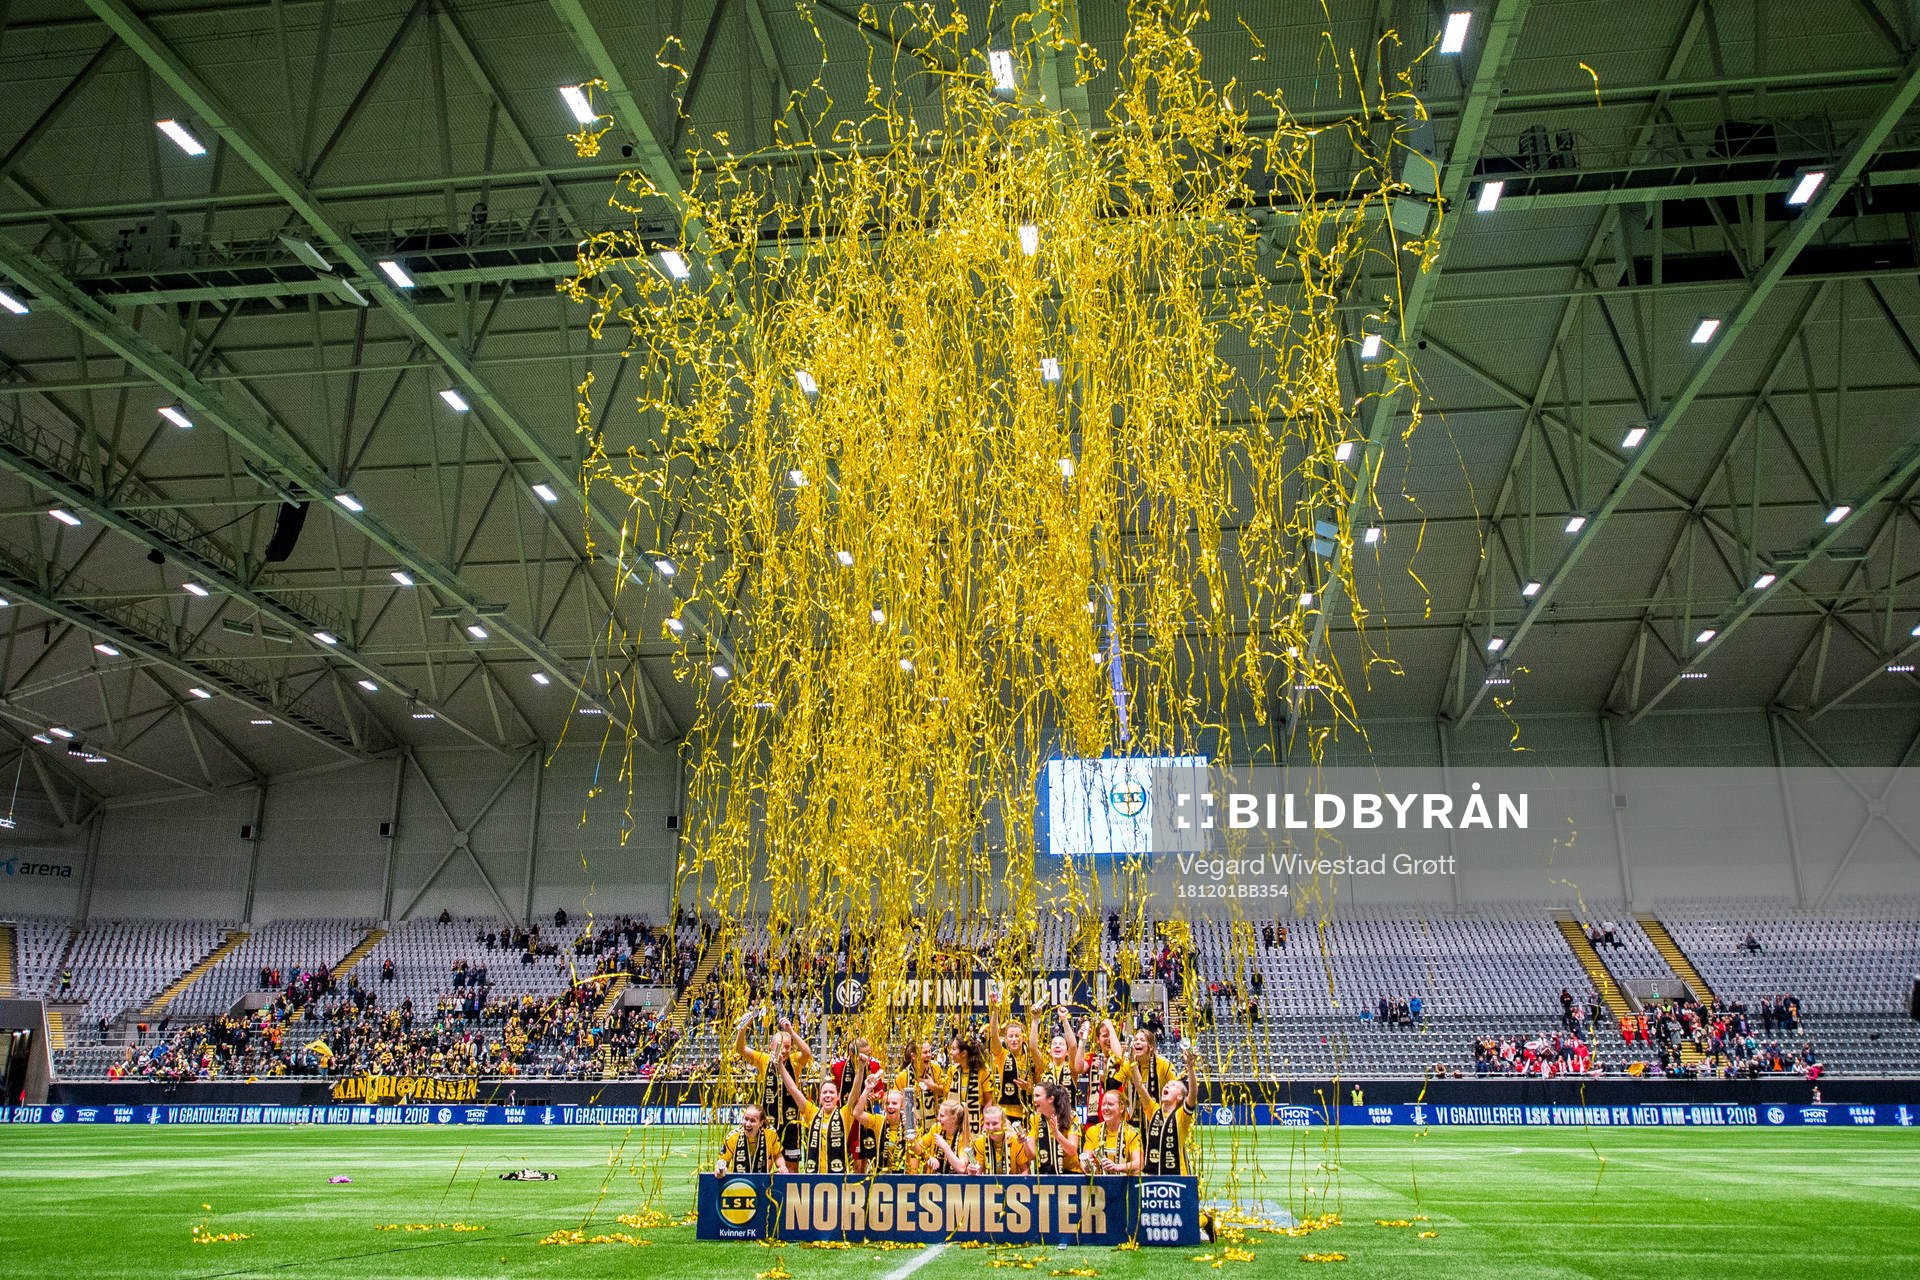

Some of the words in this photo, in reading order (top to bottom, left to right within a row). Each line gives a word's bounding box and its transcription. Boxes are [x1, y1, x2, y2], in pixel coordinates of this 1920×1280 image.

[20, 862, 72, 878] arena
[334, 1076, 397, 1099] KANRI
[414, 1077, 478, 1100] FANSEN
[13, 1107, 42, 1123] 2018
[168, 1107, 179, 1123] VI
[179, 1107, 239, 1123] GRATULERER
[240, 1107, 262, 1123] LSK
[263, 1107, 310, 1123] KVINNER
[312, 1107, 326, 1123] FK
[327, 1107, 350, 1123] MED
[404, 1107, 430, 1124] 2018
[504, 1108, 526, 1116] REMA
[506, 1115, 523, 1123] 1000
[563, 1107, 574, 1124] VI
[575, 1107, 638, 1124] GRATULERER
[1275, 1106, 1313, 1118] THON
[1368, 1108, 1393, 1116] REMA
[1436, 1107, 1448, 1124] VI
[1450, 1107, 1522, 1124] GRATULERER
[1525, 1107, 1550, 1124] LSK
[1552, 1107, 1610, 1124] KVINNER
[1612, 1107, 1629, 1124] FK
[1632, 1107, 1659, 1124] MED
[1727, 1107, 1757, 1124] 2018
[1848, 1107, 1876, 1116] REMA
[1371, 1116, 1391, 1124] 1000
[1165, 1150, 1176, 1169] CUP
[1134, 1181, 1187, 1199] THON
[722, 1198, 756, 1208] LSK
[785, 1183, 1107, 1234] NORGESMESTER
[1141, 1199, 1181, 1209] HOTELS
[1140, 1212, 1183, 1227] REMA
[719, 1229, 746, 1238] Kvinner
[747, 1229, 756, 1238] FK
[1146, 1227, 1179, 1242] 1000
